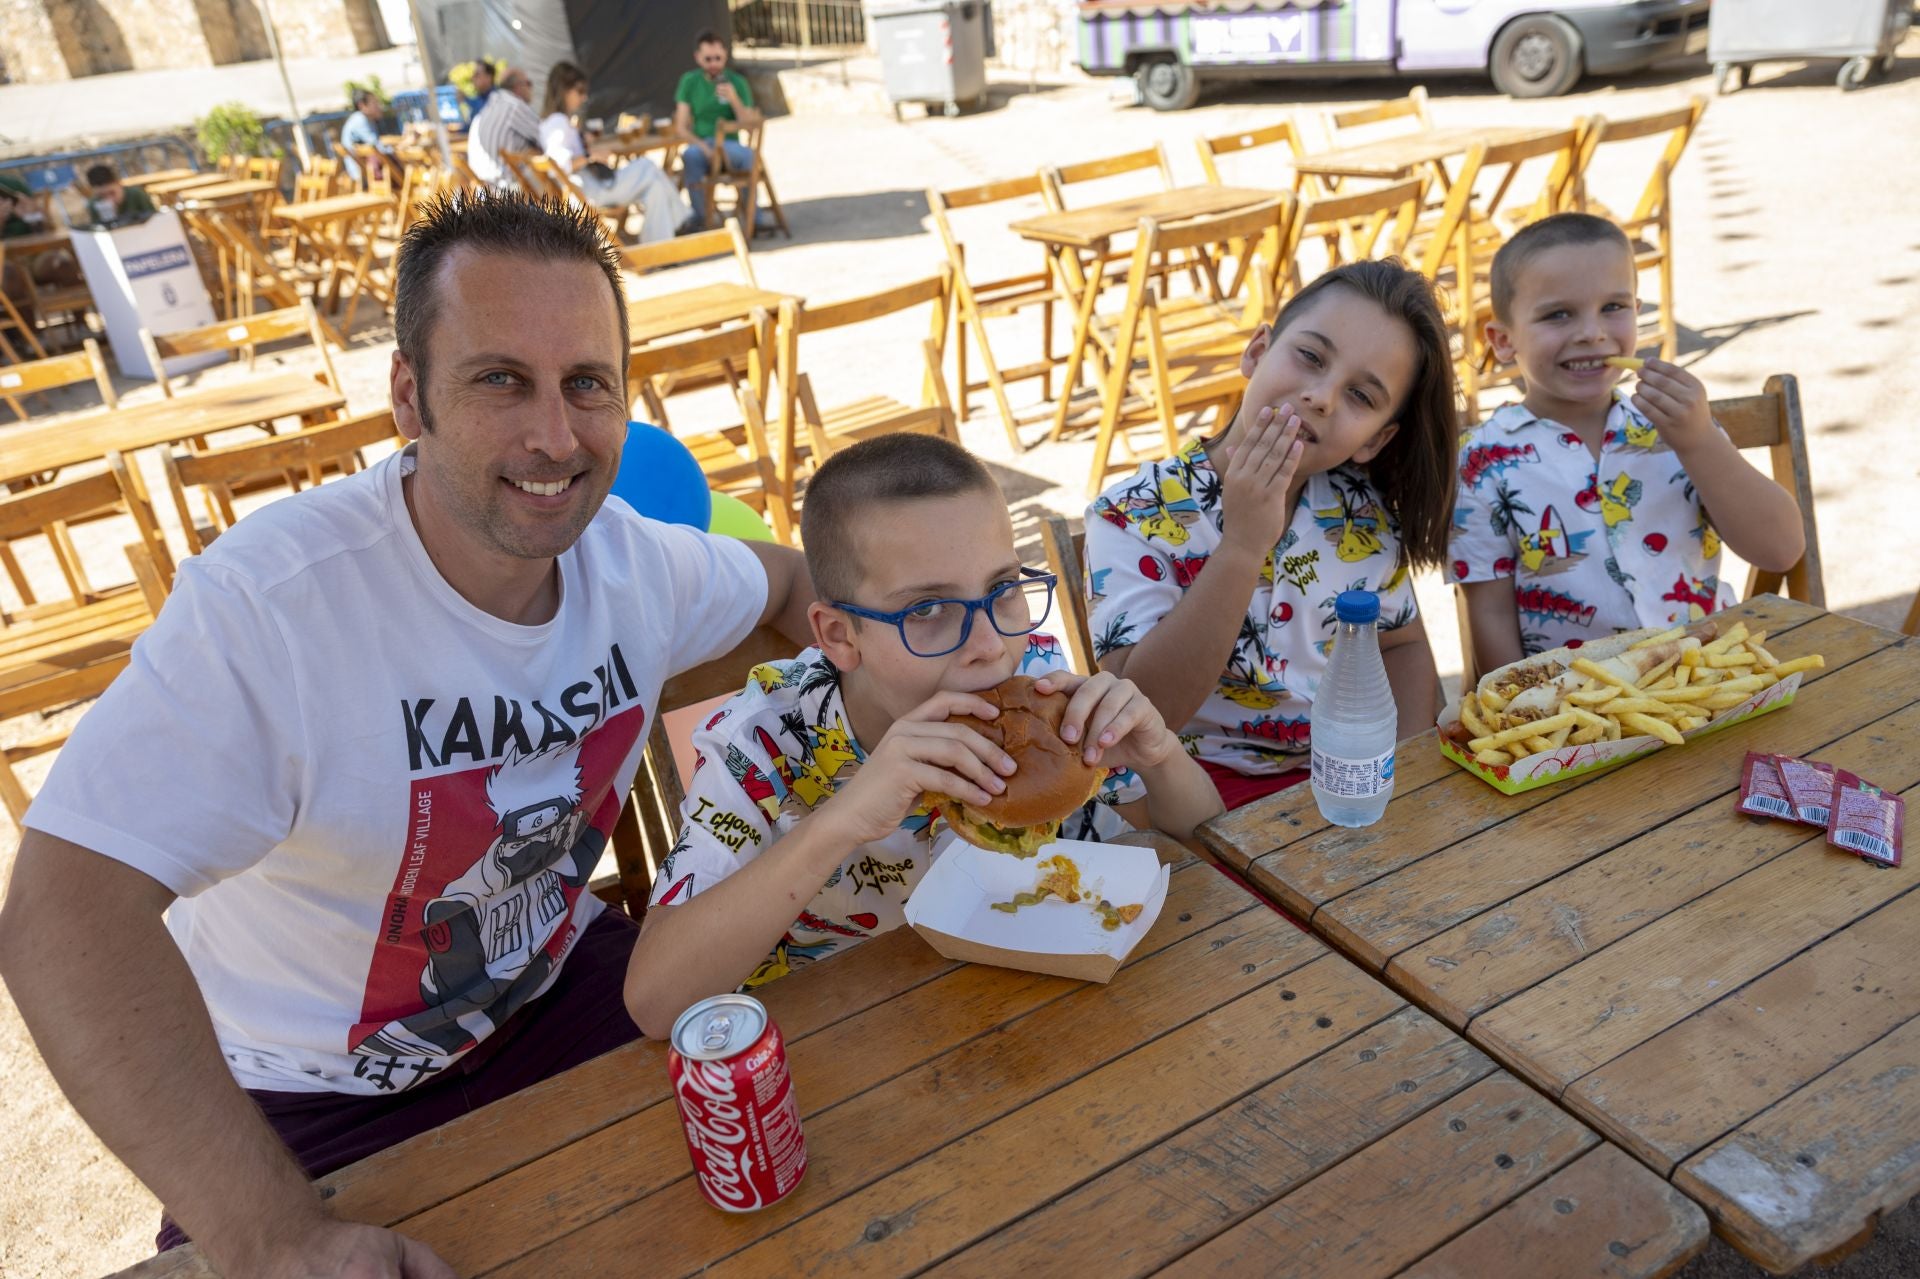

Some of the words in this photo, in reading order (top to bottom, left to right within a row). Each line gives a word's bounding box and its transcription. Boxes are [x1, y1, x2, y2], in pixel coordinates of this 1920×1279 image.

[401, 643, 639, 771] KAKASHI
[415, 790, 433, 841] VILLAGE
[690, 796, 714, 823] I
[408, 842, 428, 867] LEAF
[399, 868, 421, 896] HIDDEN
[846, 863, 864, 895] I
[384, 896, 408, 945] ONOHA
[677, 1056, 757, 1212] Coca-Cola
[745, 1101, 761, 1143] ORIGINAL
[755, 1143, 768, 1172] SABOR
